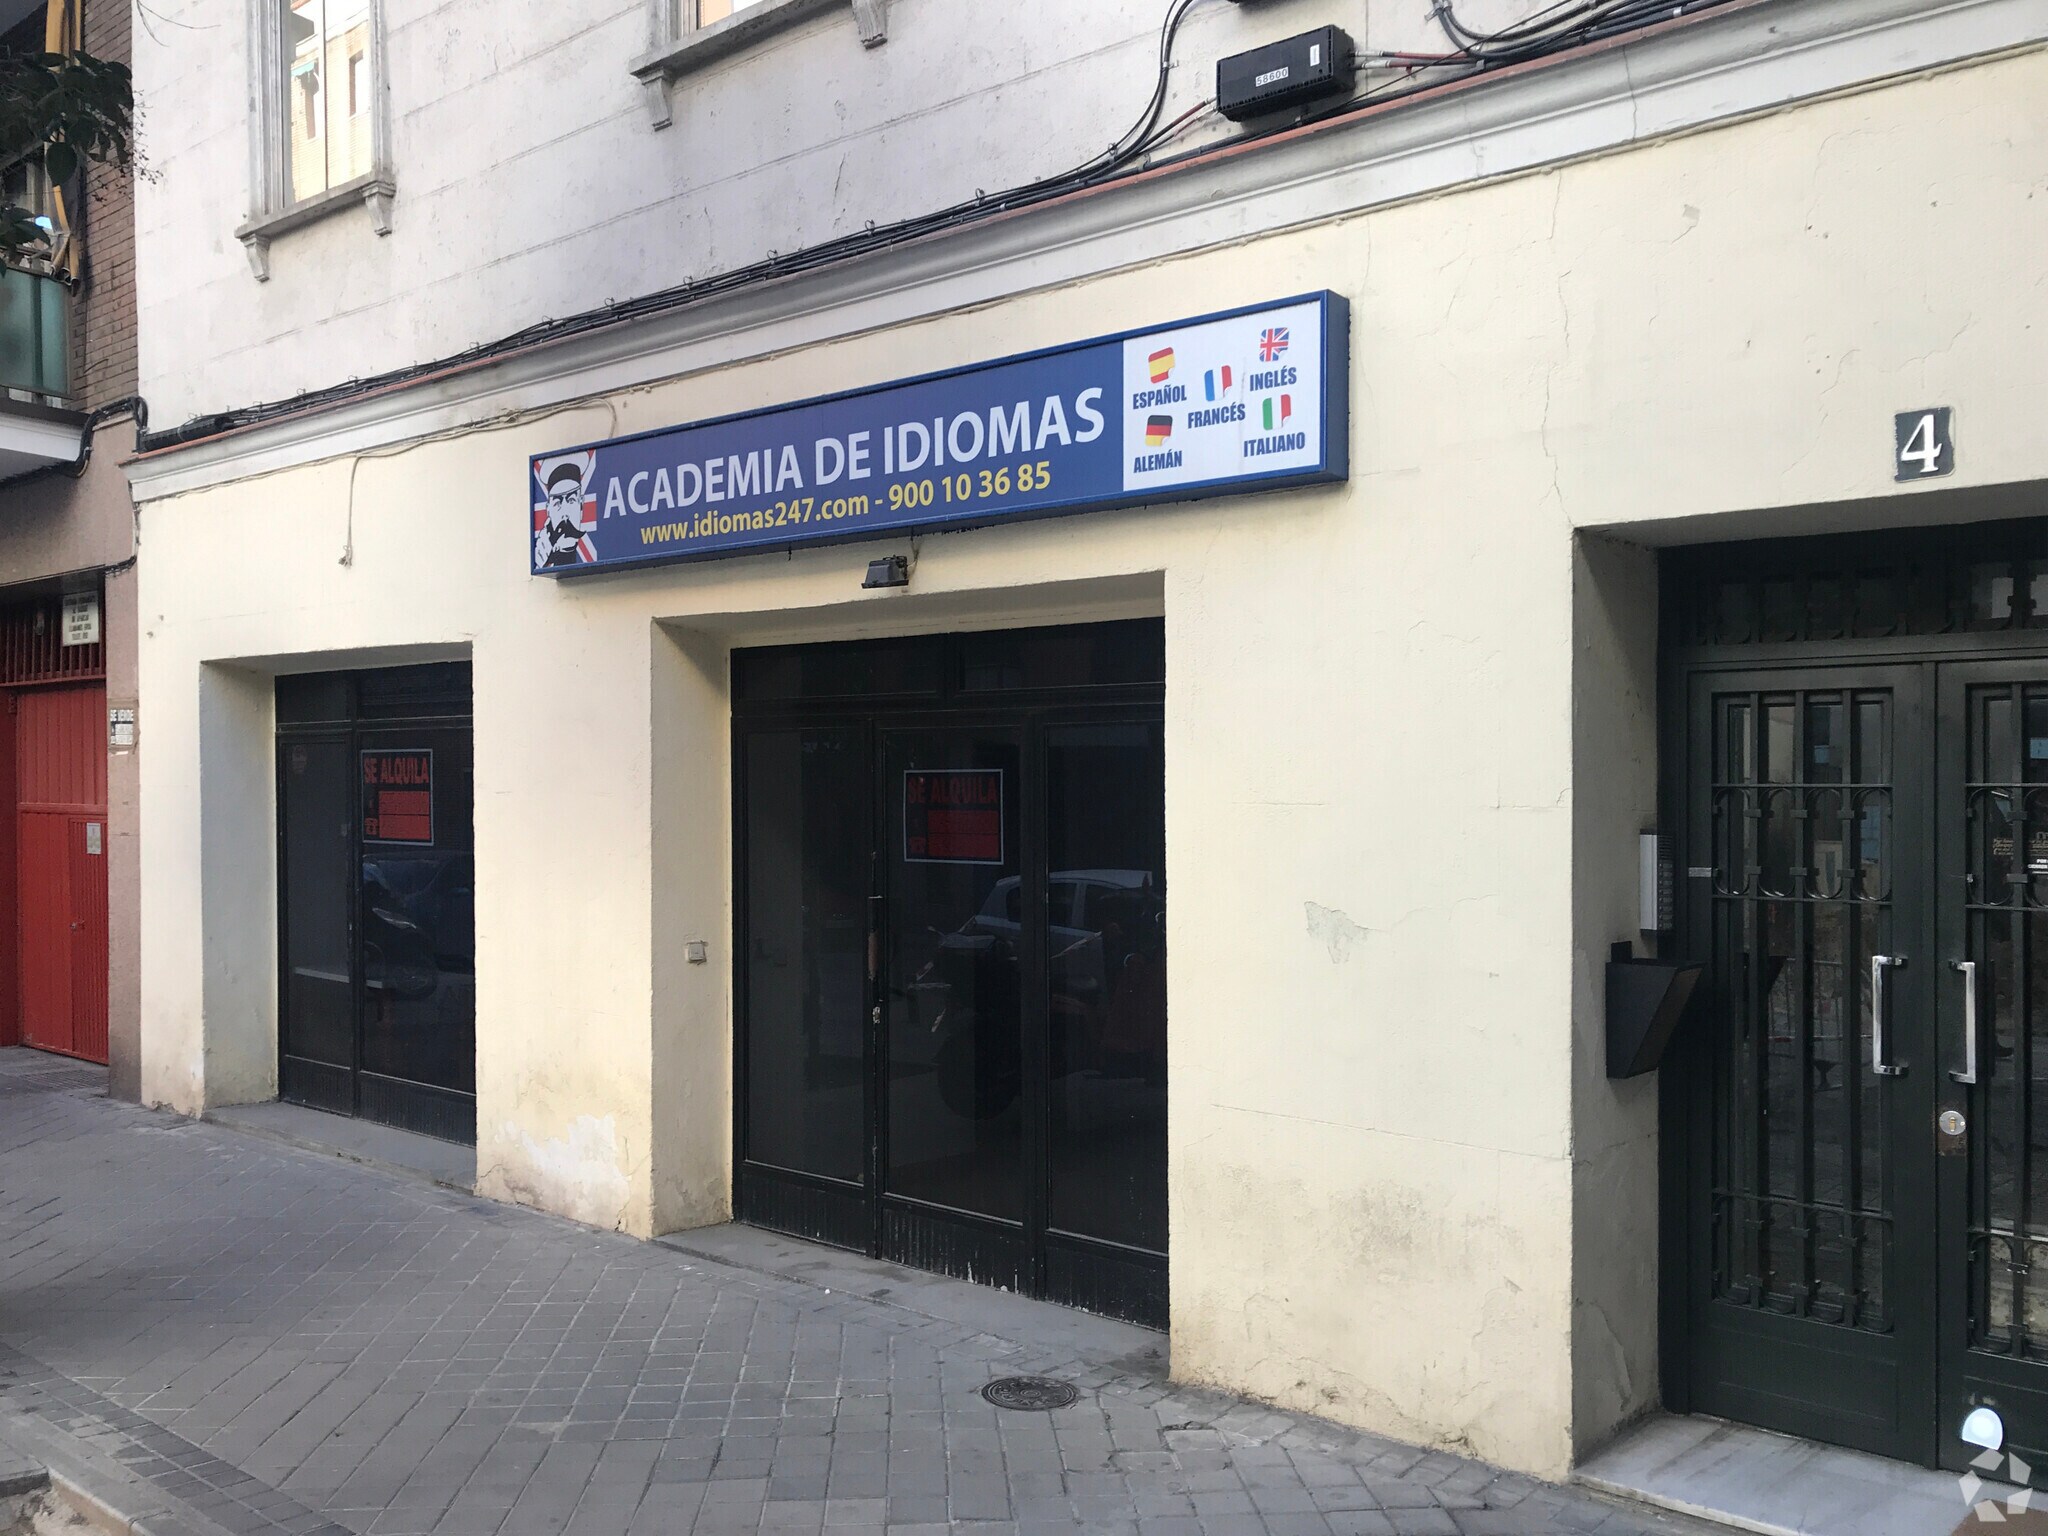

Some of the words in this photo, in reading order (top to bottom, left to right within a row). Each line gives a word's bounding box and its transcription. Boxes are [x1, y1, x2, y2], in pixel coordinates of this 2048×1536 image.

[1256, 68, 1288, 86] 58600
[1249, 365, 1297, 391] INGLÉS
[1132, 385, 1187, 410] ESPAÑOL
[1187, 403, 1246, 429] FRANCÉS
[603, 445, 804, 519] ACADEMIA
[815, 431, 872, 486] DE
[884, 387, 1105, 475] IDIOMAS
[1243, 432, 1306, 457] ITALIANO
[1901, 414, 1943, 473] 4
[1133, 449, 1183, 474] ALEMÁN
[640, 494, 869, 544] www.idiomas247.com
[888, 479, 935, 511] 900
[941, 473, 972, 503] 10
[978, 466, 1011, 498] 36
[1017, 460, 1051, 492] 85
[364, 757, 378, 784] SE
[381, 757, 430, 785] ALQUILA
[908, 777, 925, 804] SE
[931, 777, 998, 804] ALQUILA
